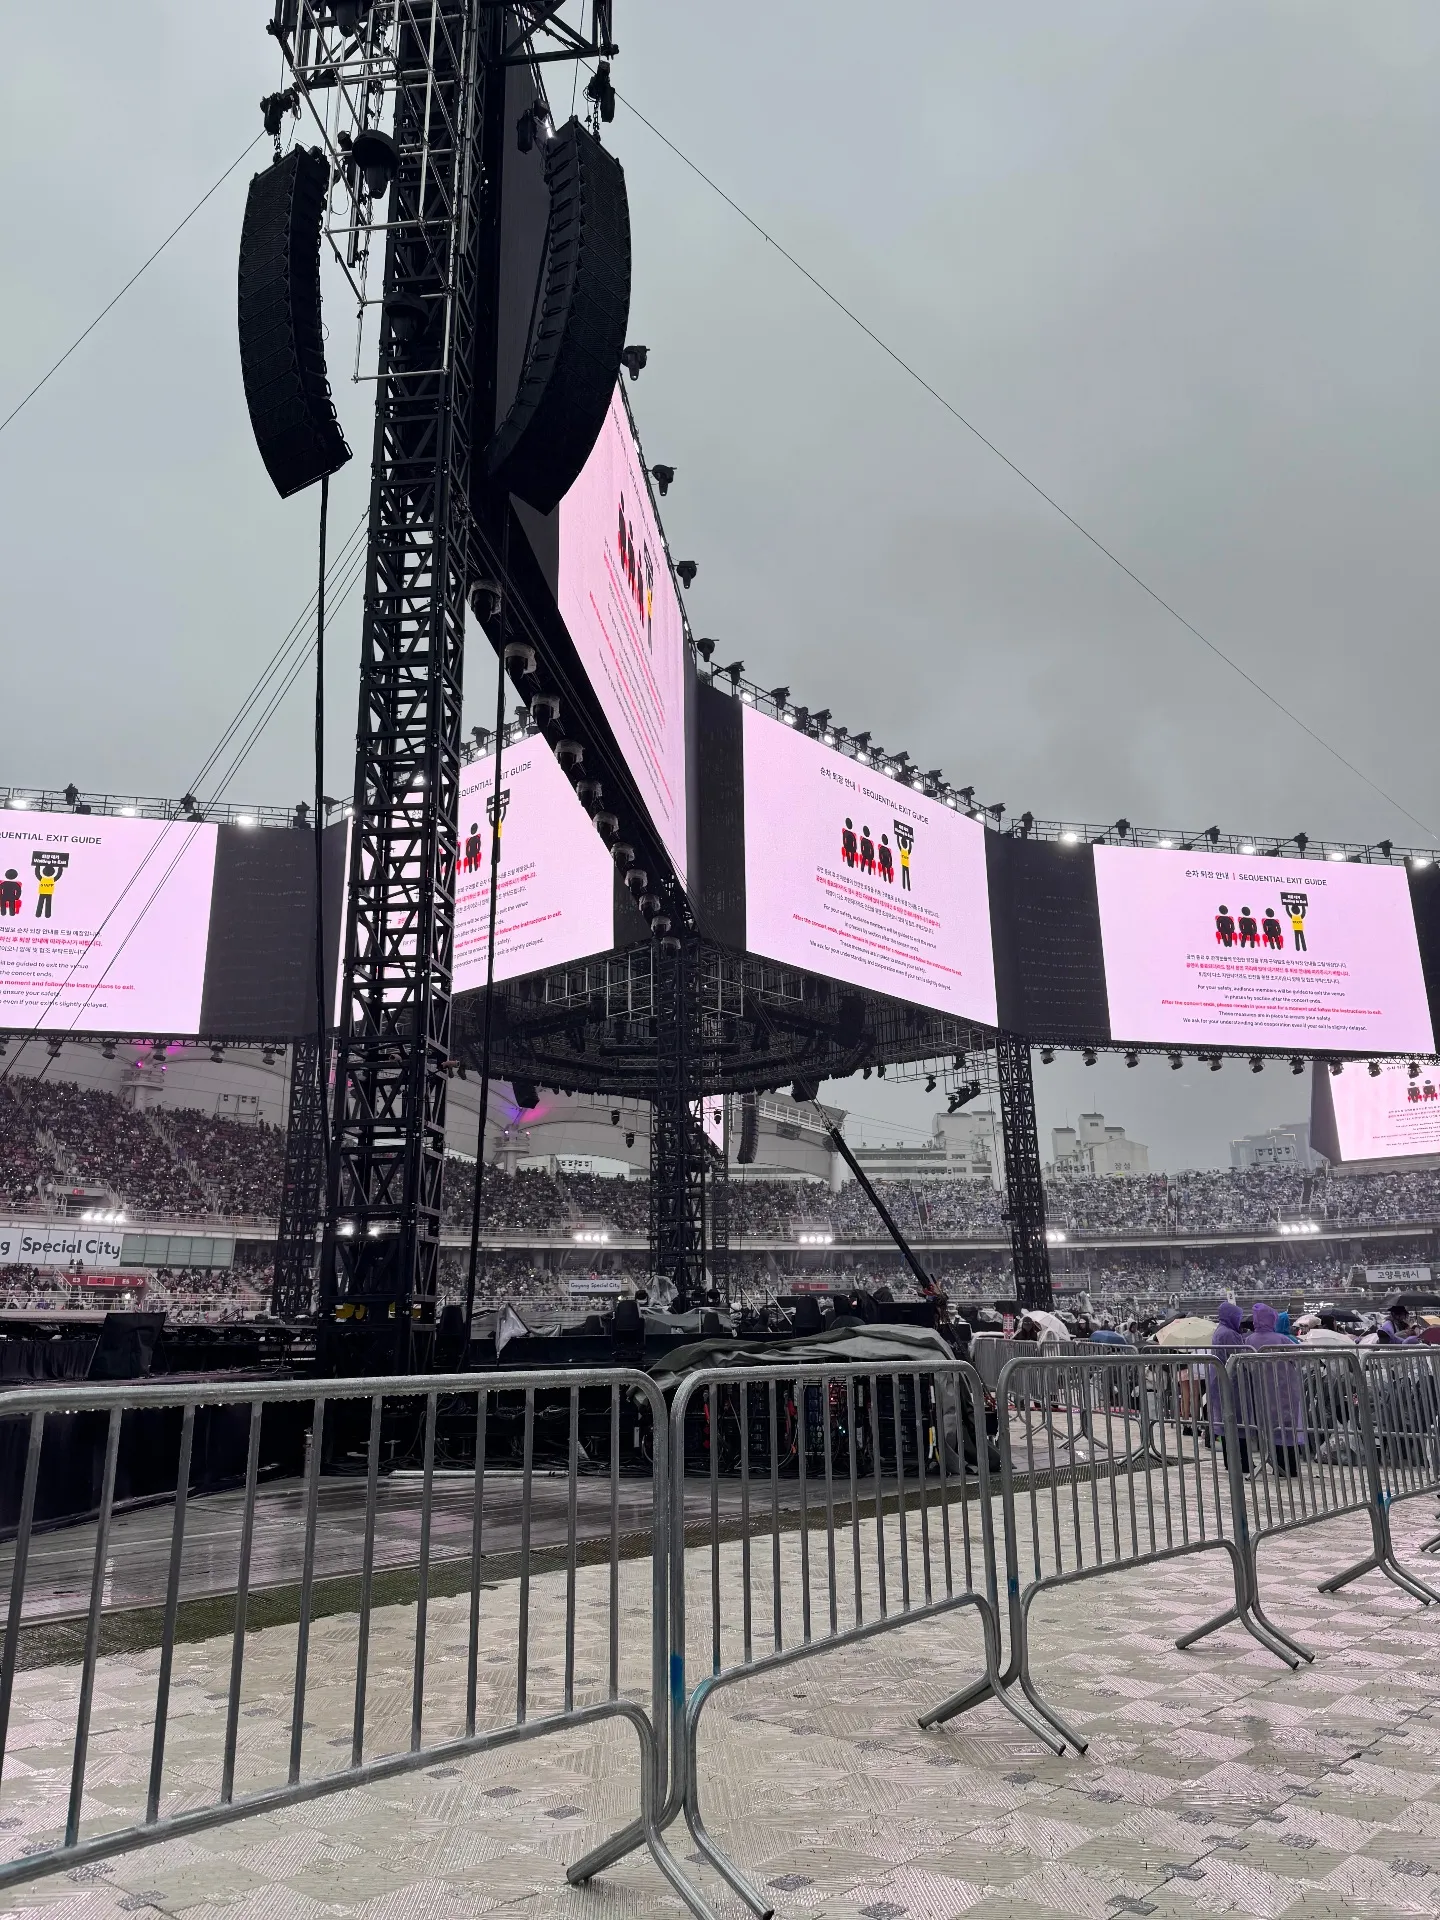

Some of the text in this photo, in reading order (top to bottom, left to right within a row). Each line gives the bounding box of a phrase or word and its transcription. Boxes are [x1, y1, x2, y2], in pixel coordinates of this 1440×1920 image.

[510, 761, 532, 776] GUIDE
[862, 786, 897, 810] SEQUENTIAL
[898, 804, 911, 816] EXIT
[911, 810, 928, 824] GUIDE
[45, 834, 68, 842] EXIT
[70, 835, 102, 844] GUIDE
[1238, 873, 1284, 882] SEQUENTIAL
[22, 1237, 82, 1254] Special
[85, 1240, 120, 1259] City
